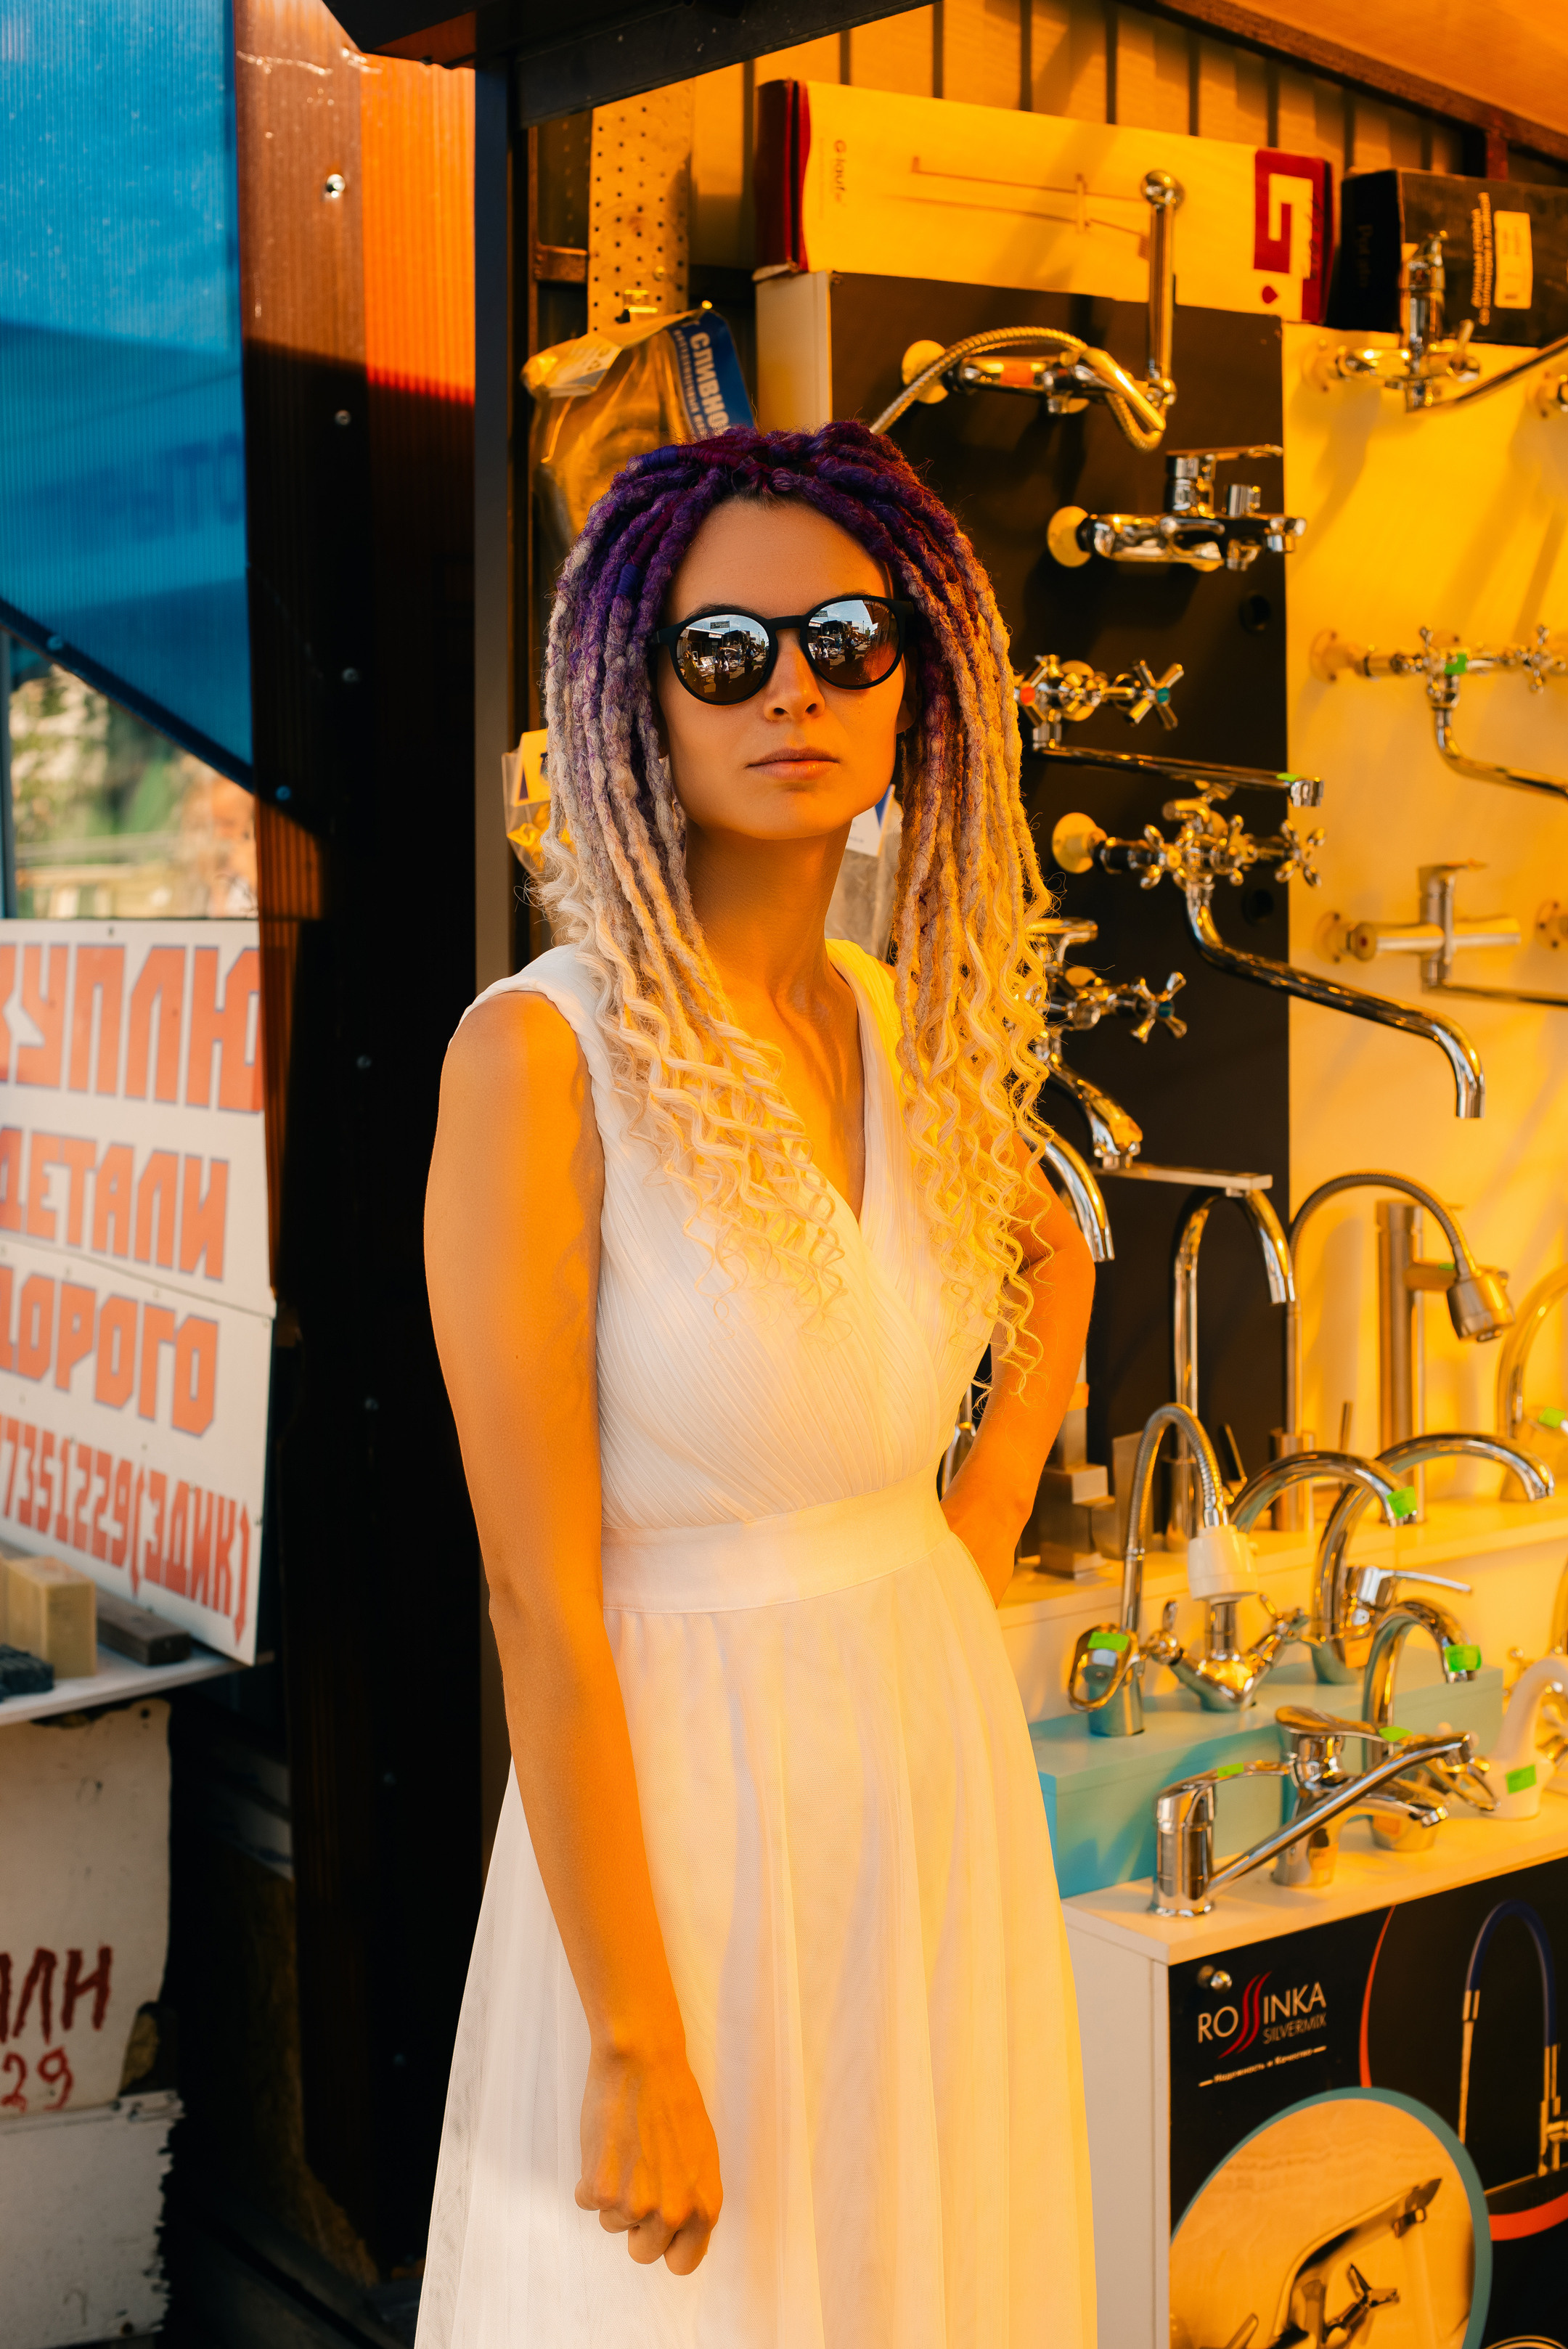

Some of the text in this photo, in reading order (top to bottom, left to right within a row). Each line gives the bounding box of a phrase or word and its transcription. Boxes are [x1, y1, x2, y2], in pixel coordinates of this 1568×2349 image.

[0, 1412, 250, 1646] 7351229(ЭДИК)
[1198, 1971, 1327, 2059] ROSSINKA
[1262, 2011, 1327, 2045] SILVERMIX
[1, 2046, 74, 2113] 29
